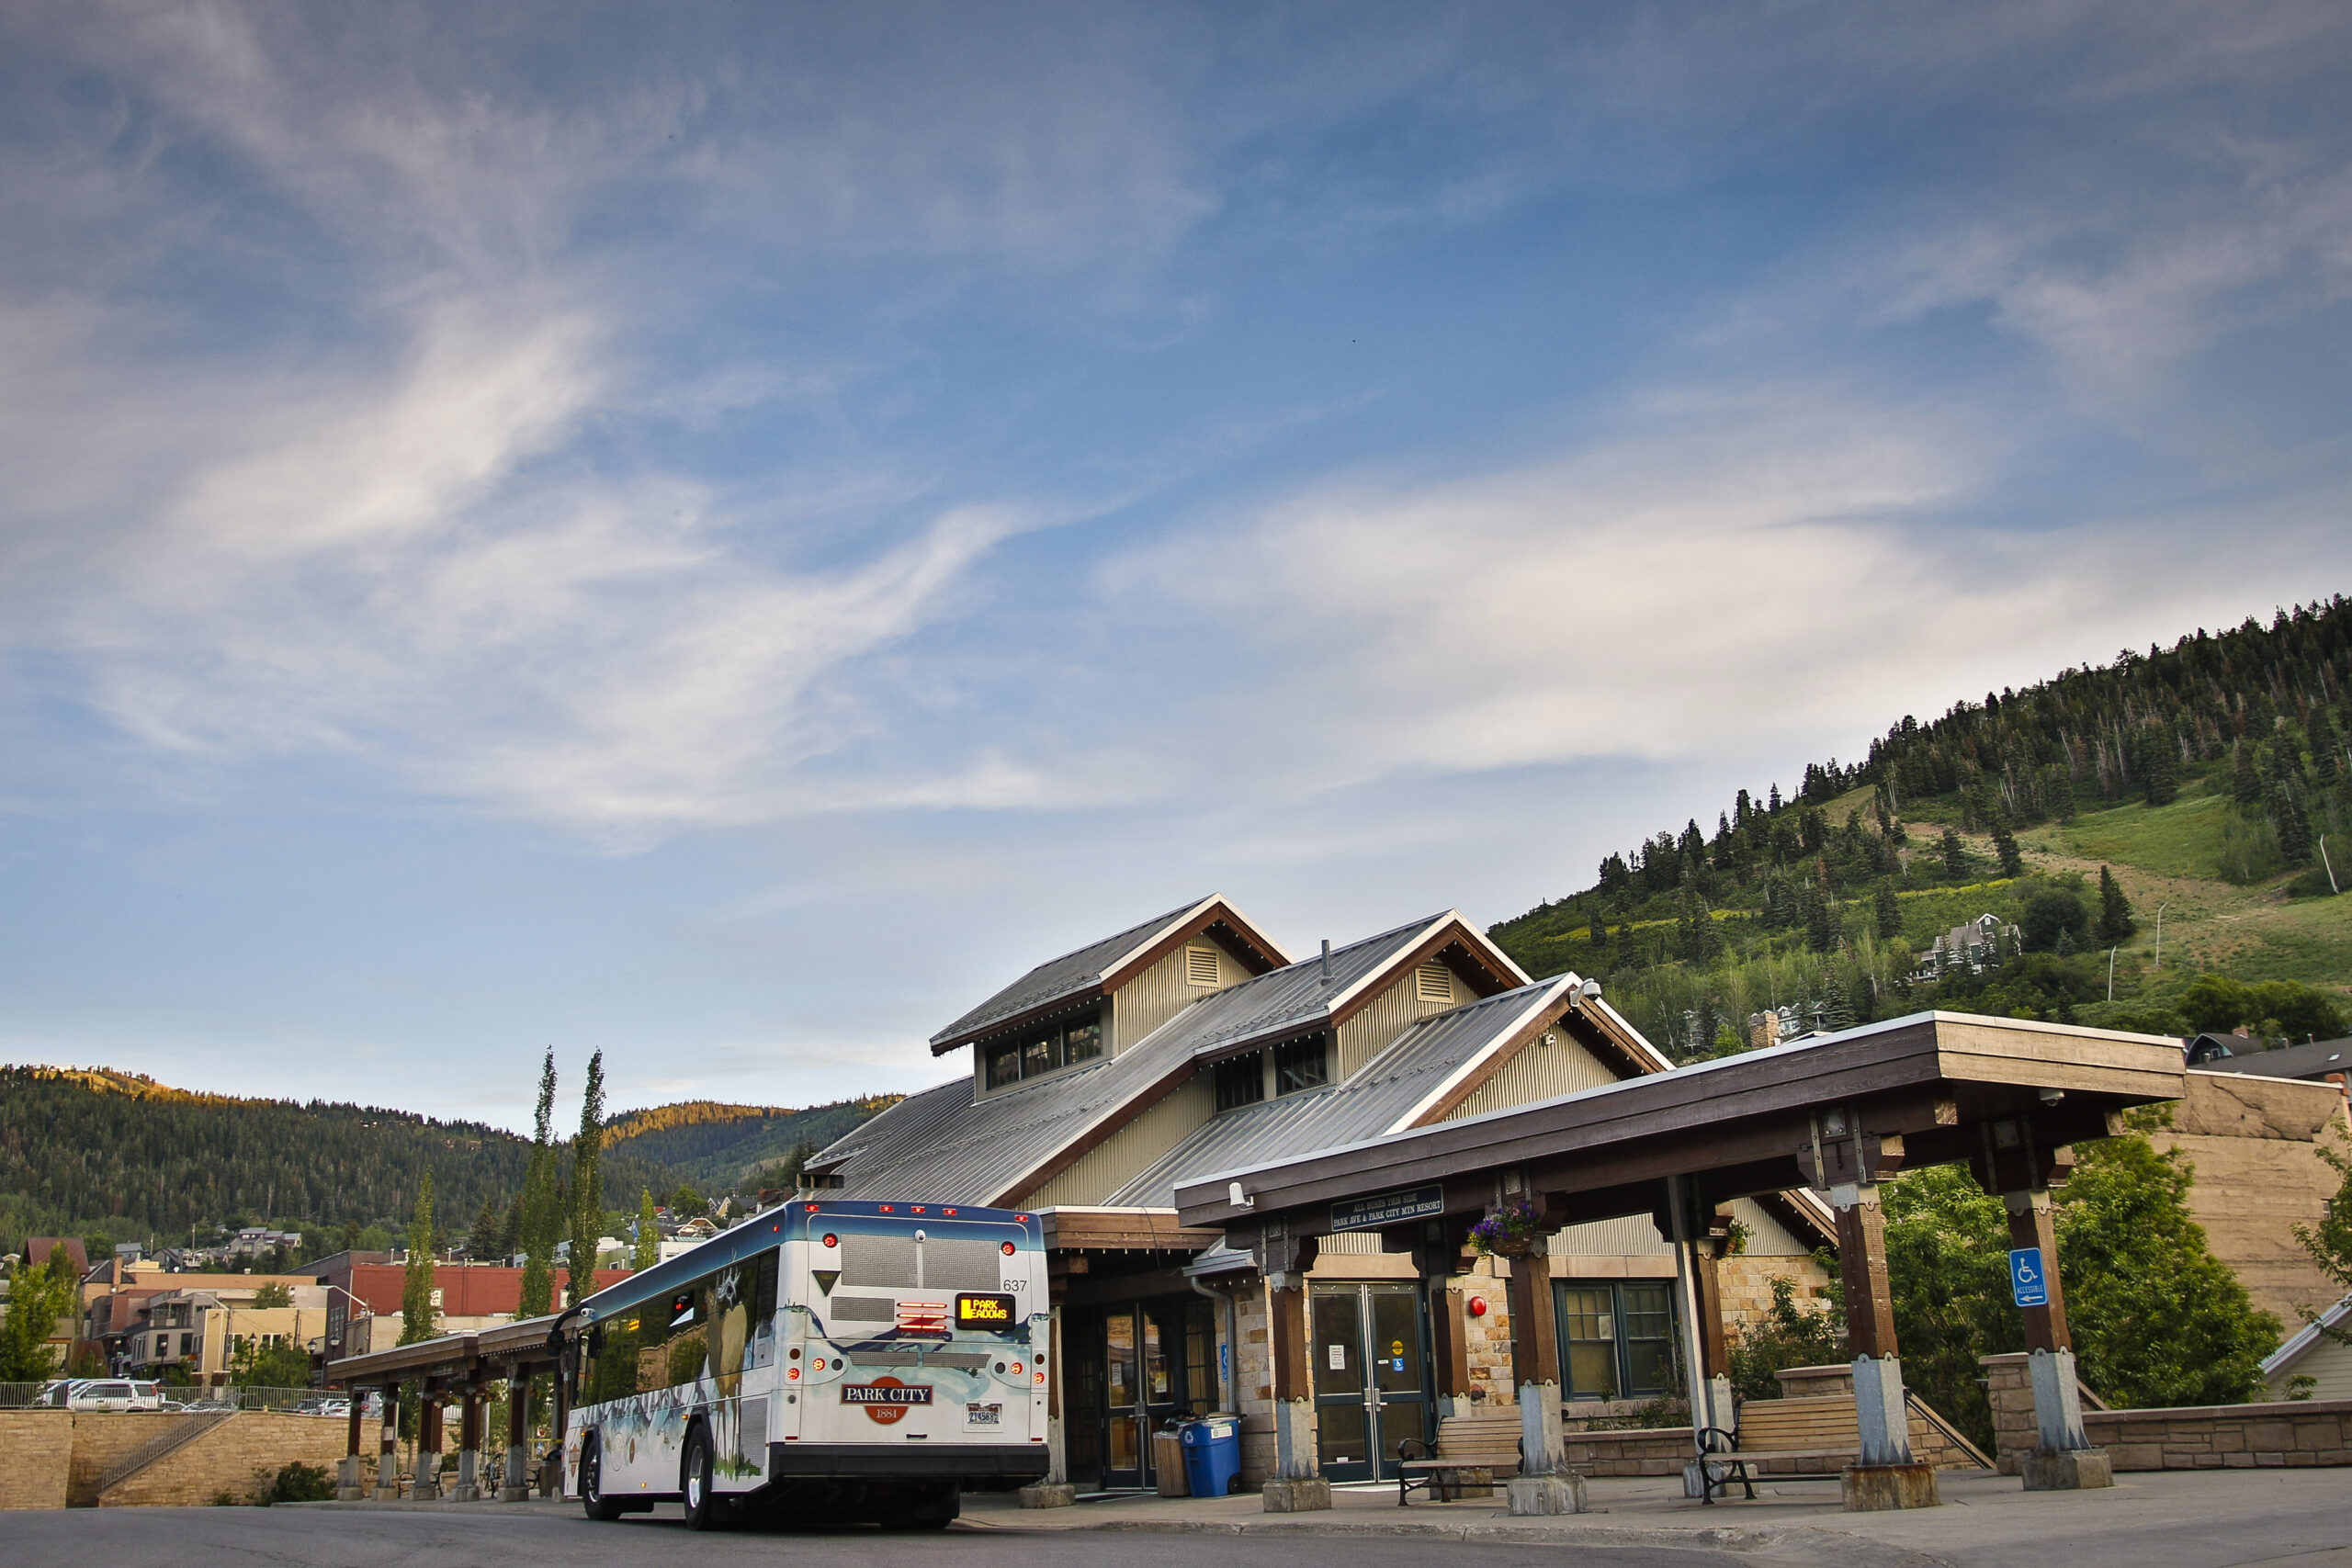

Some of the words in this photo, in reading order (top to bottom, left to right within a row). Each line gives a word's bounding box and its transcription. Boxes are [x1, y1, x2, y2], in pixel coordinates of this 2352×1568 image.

[1353, 1204, 1365, 1213] ALL
[1367, 1199, 1385, 1210] BUSES
[1387, 1196, 1401, 1206] THIS
[1403, 1193, 1418, 1203] SIDE
[1333, 1218, 1348, 1227] PARK
[1350, 1214, 1361, 1224] AVE
[1369, 1212, 1385, 1221] PARK
[1385, 1209, 1400, 1218] CITY
[1401, 1205, 1415, 1215] MTN
[1417, 1201, 1442, 1213] RESORT
[1003, 1280, 1027, 1292] 637
[2017, 1285, 2044, 1293] ACCESSIBLE
[973, 1300, 999, 1309] PARK
[969, 1309, 1008, 1319] EADOWS
[845, 1388, 886, 1401] PARK
[889, 1388, 929, 1402] CITY
[876, 1408, 897, 1418] 1884
